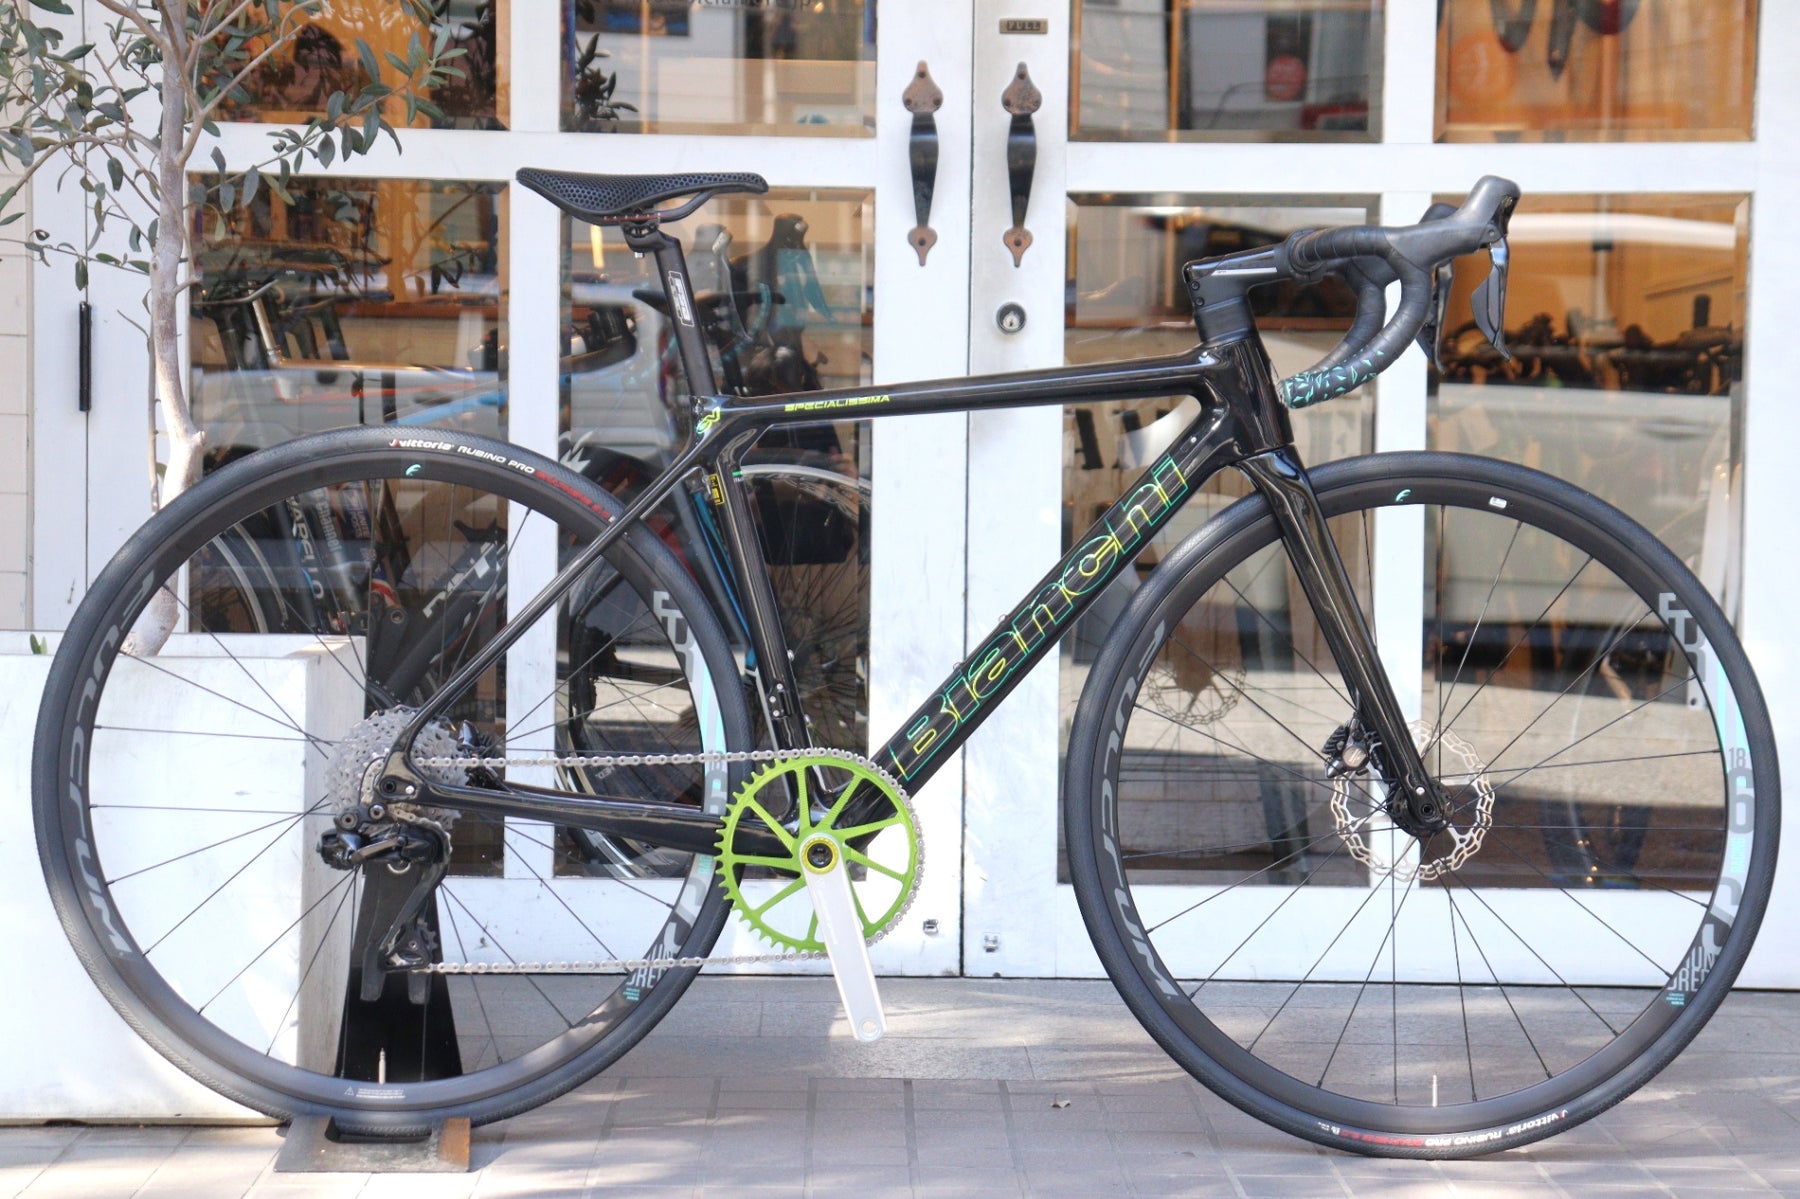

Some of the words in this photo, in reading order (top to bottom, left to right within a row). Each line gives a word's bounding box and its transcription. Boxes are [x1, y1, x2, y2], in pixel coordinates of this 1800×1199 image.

[784, 395, 890, 412] SPECIALISSIMA
[457, 445, 506, 464] RUBINO
[507, 459, 535, 474] PRO
